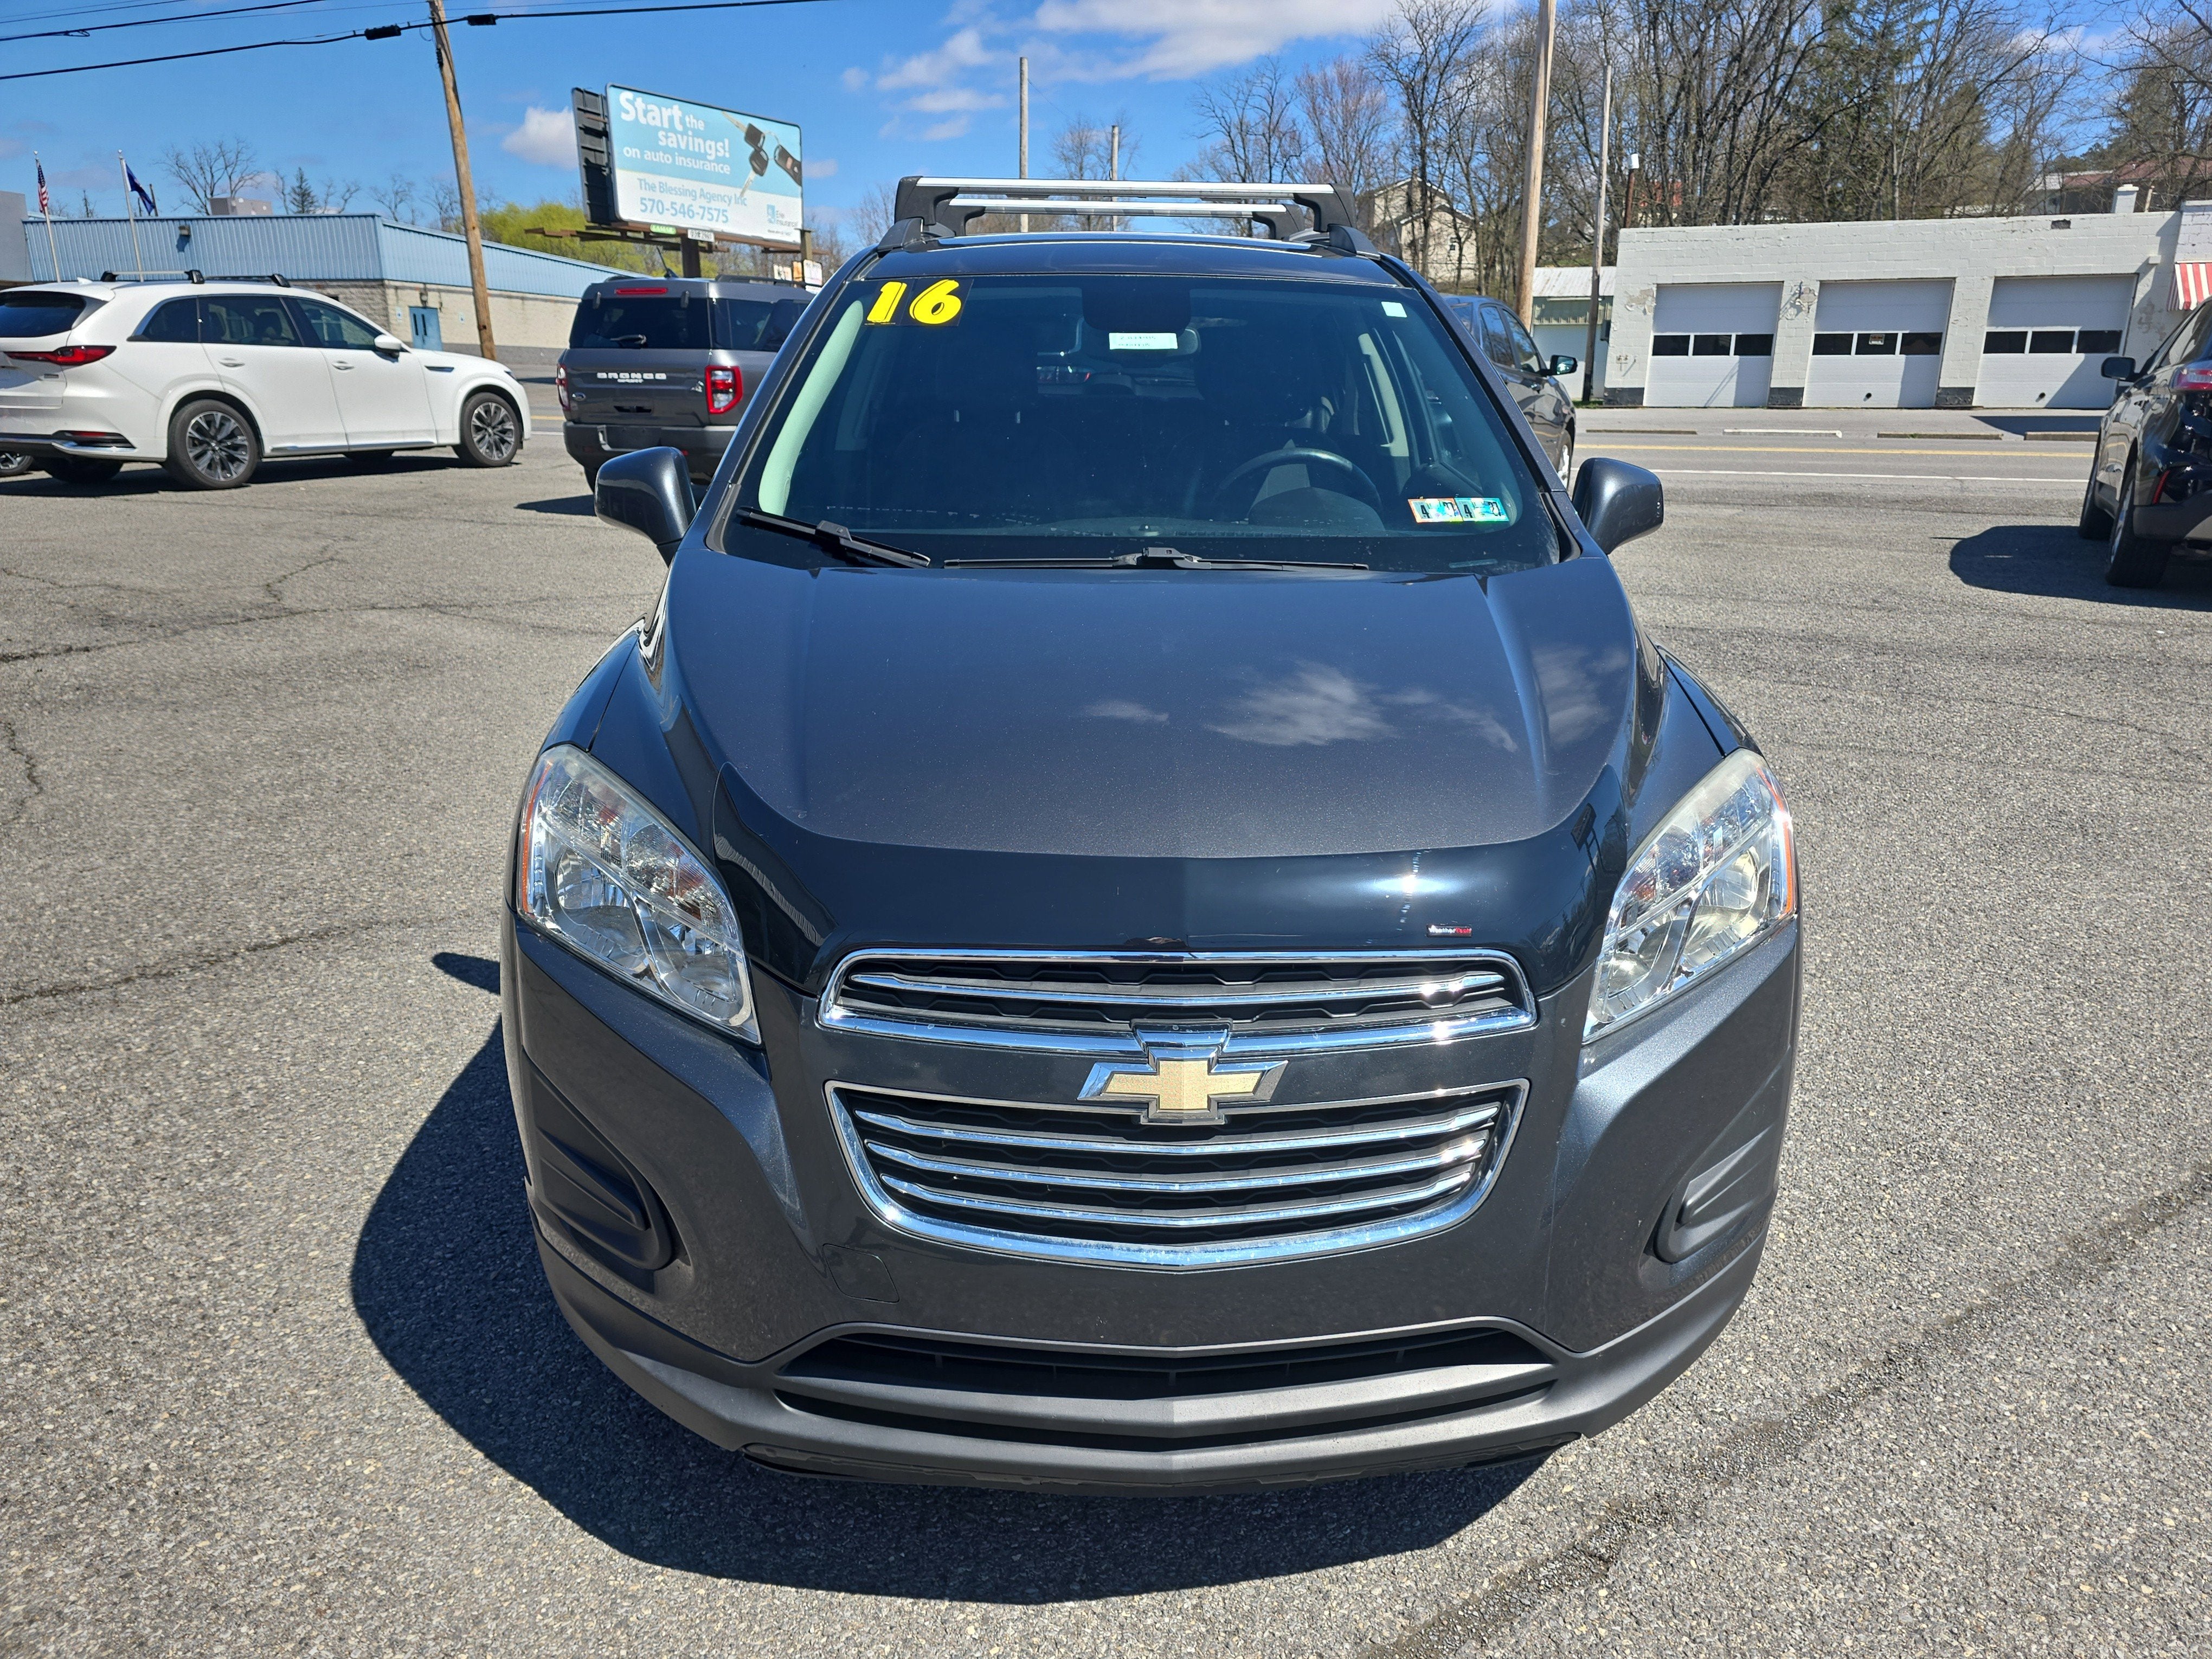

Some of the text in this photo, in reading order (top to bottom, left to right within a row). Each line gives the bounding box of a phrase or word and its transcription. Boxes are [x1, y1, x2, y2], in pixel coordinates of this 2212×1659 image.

[619, 91, 704, 131] Start the
[658, 130, 730, 160] savings!
[623, 146, 731, 175] on auto insurance
[637, 178, 747, 207] The Blessing Agency Inc
[640, 197, 729, 223] 570-546-7575
[867, 279, 961, 324] 16
[1420, 504, 1431, 518] 4
[1463, 504, 1473, 518] 4
